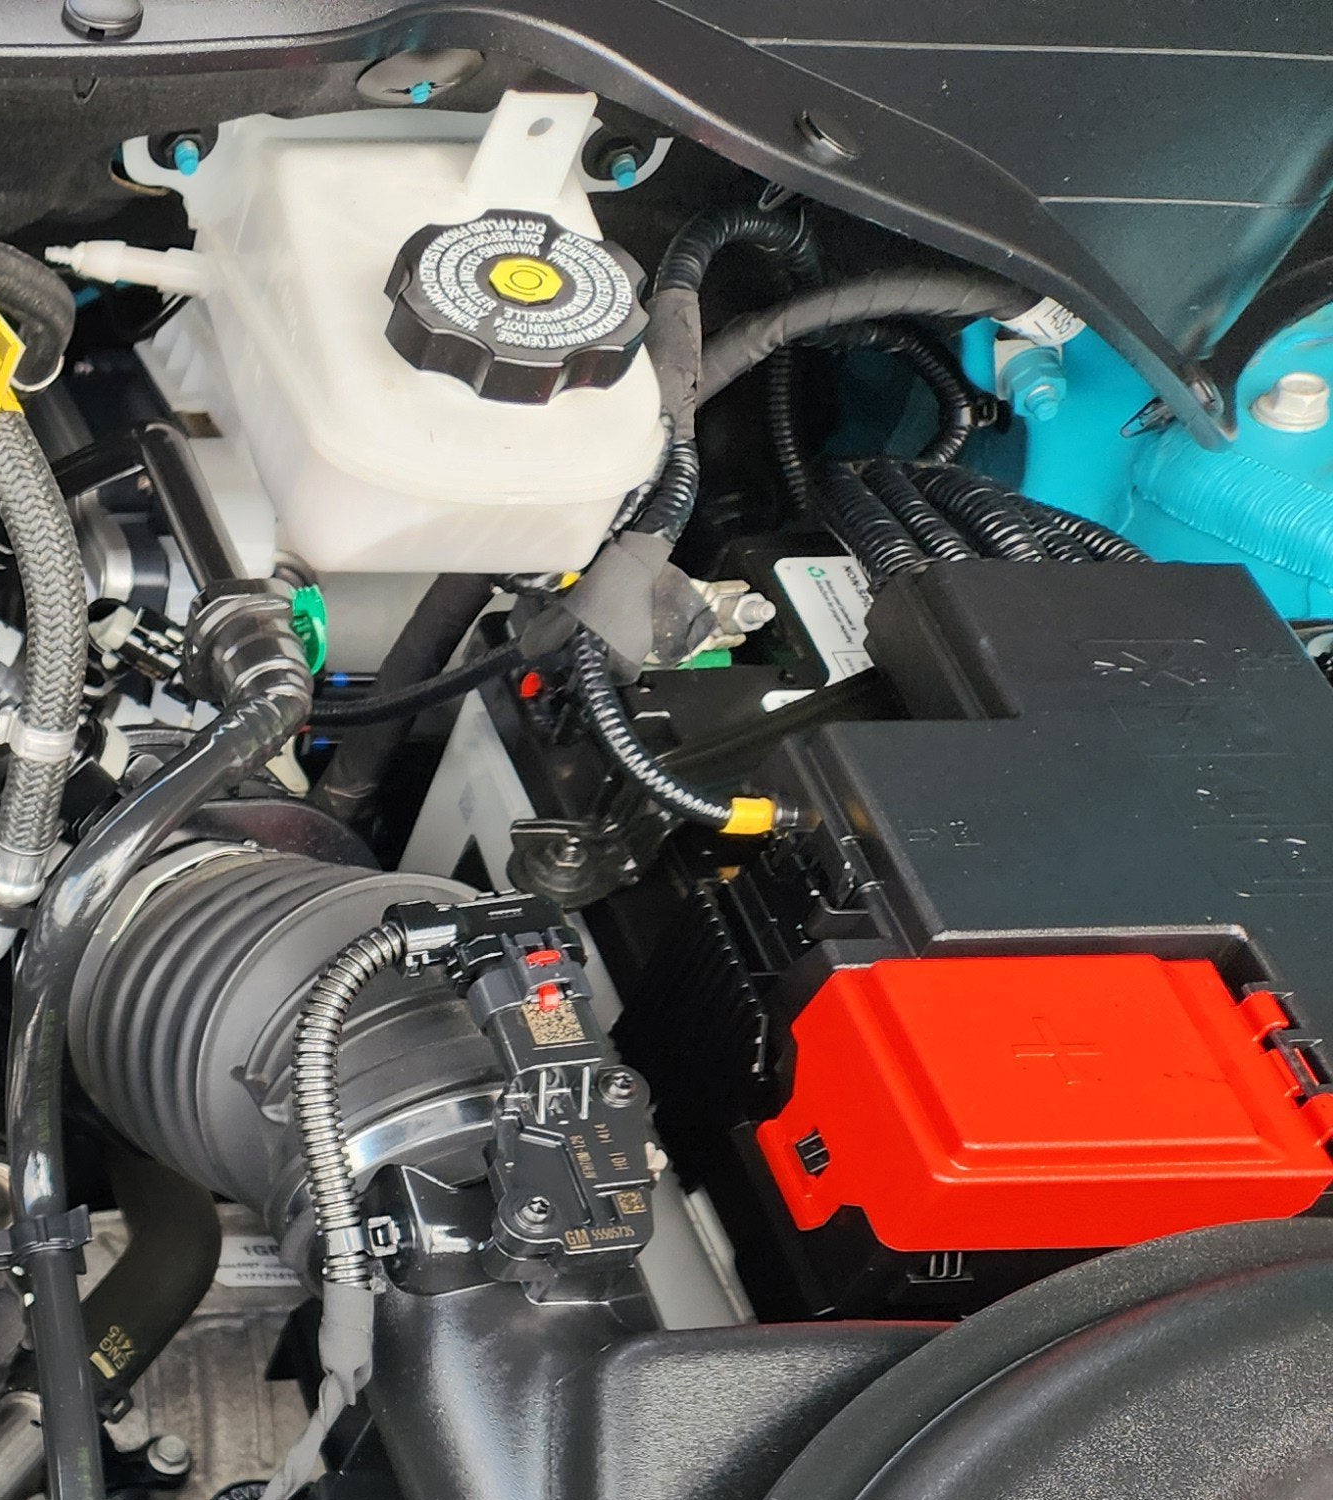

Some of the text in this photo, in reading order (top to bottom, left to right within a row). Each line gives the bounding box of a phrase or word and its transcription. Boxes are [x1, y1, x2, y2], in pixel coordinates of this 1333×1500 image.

[466, 220, 508, 233] FLUID
[506, 220, 517, 230] 4
[517, 220, 547, 234] DOT
[432, 225, 473, 247] FROM
[462, 231, 513, 247] BEFORE
[513, 232, 545, 244] CAP
[472, 243, 542, 259] WARNING:
[418, 248, 443, 281] SEALED
[451, 297, 489, 321] ONLY
[490, 316, 505, 328] 4
[500, 319, 527, 333] DOT
[564, 1228, 590, 1246] GM
[107, 1324, 136, 1361] 7415
[99, 1337, 128, 1370] ENG
